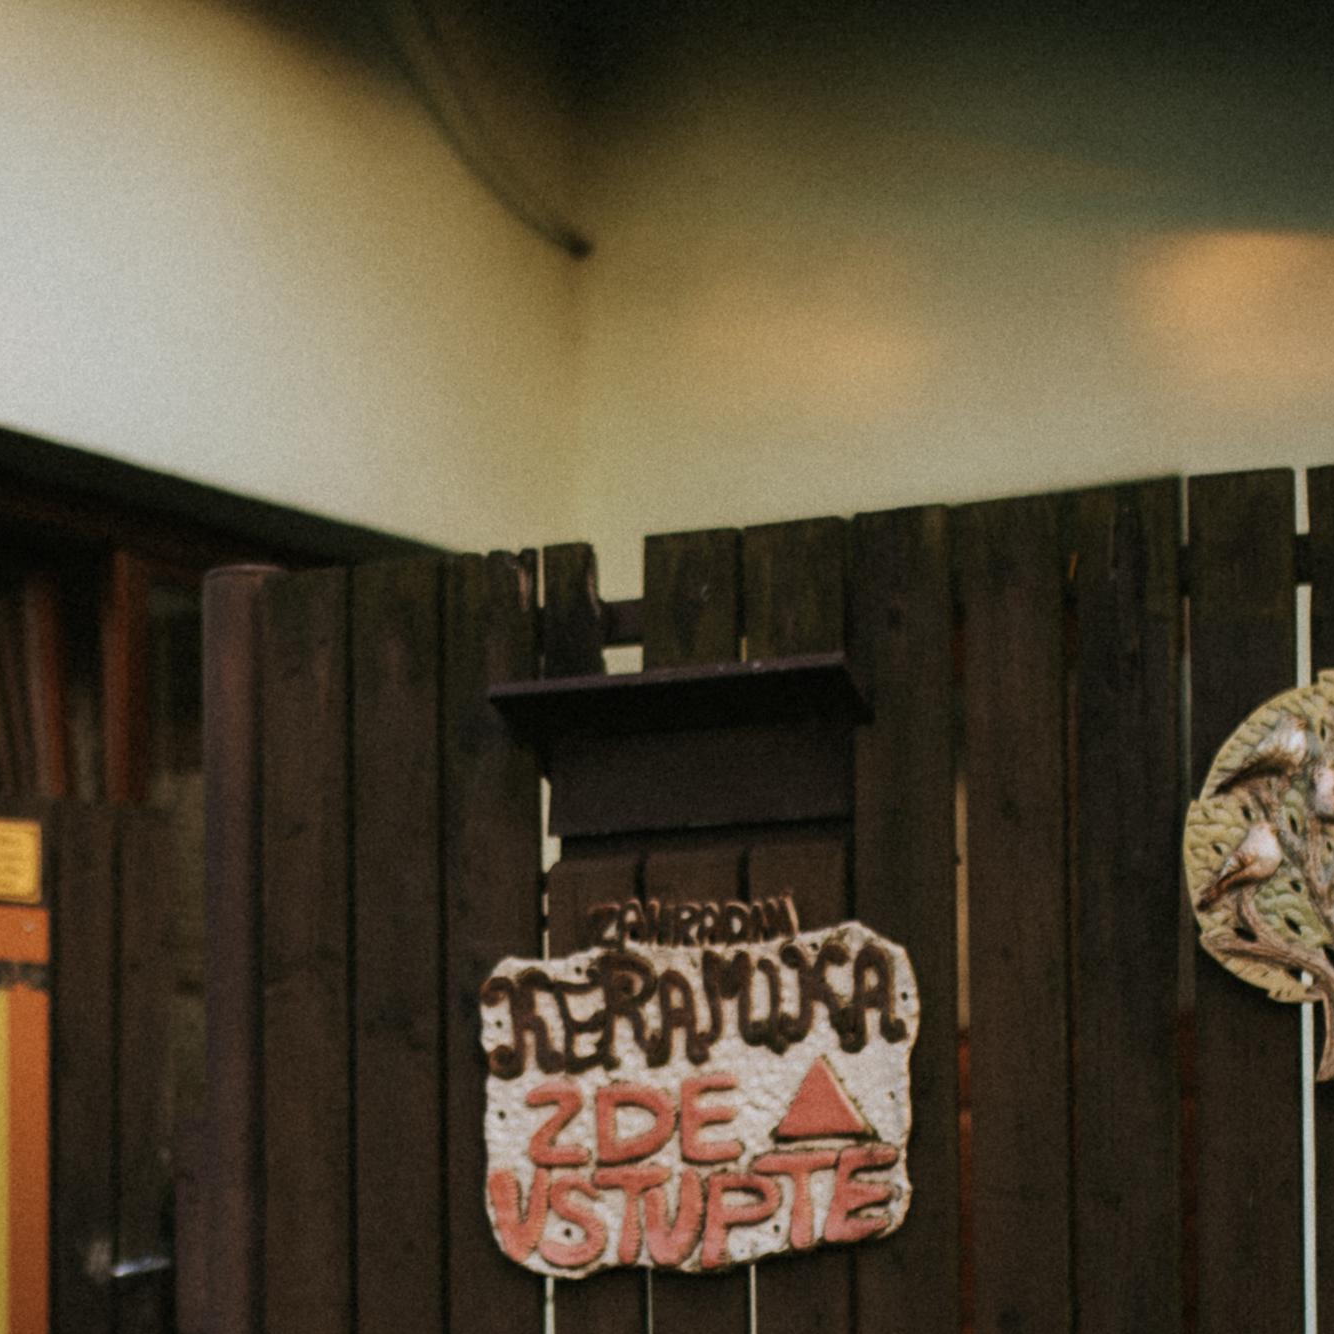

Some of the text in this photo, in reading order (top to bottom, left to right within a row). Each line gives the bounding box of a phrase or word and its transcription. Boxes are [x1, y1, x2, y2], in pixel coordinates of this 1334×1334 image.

[480, 941, 909, 1079] KERAMIKA
[525, 1073, 744, 1167] ZDE
[487, 1145, 899, 1269] VSTUPTE
